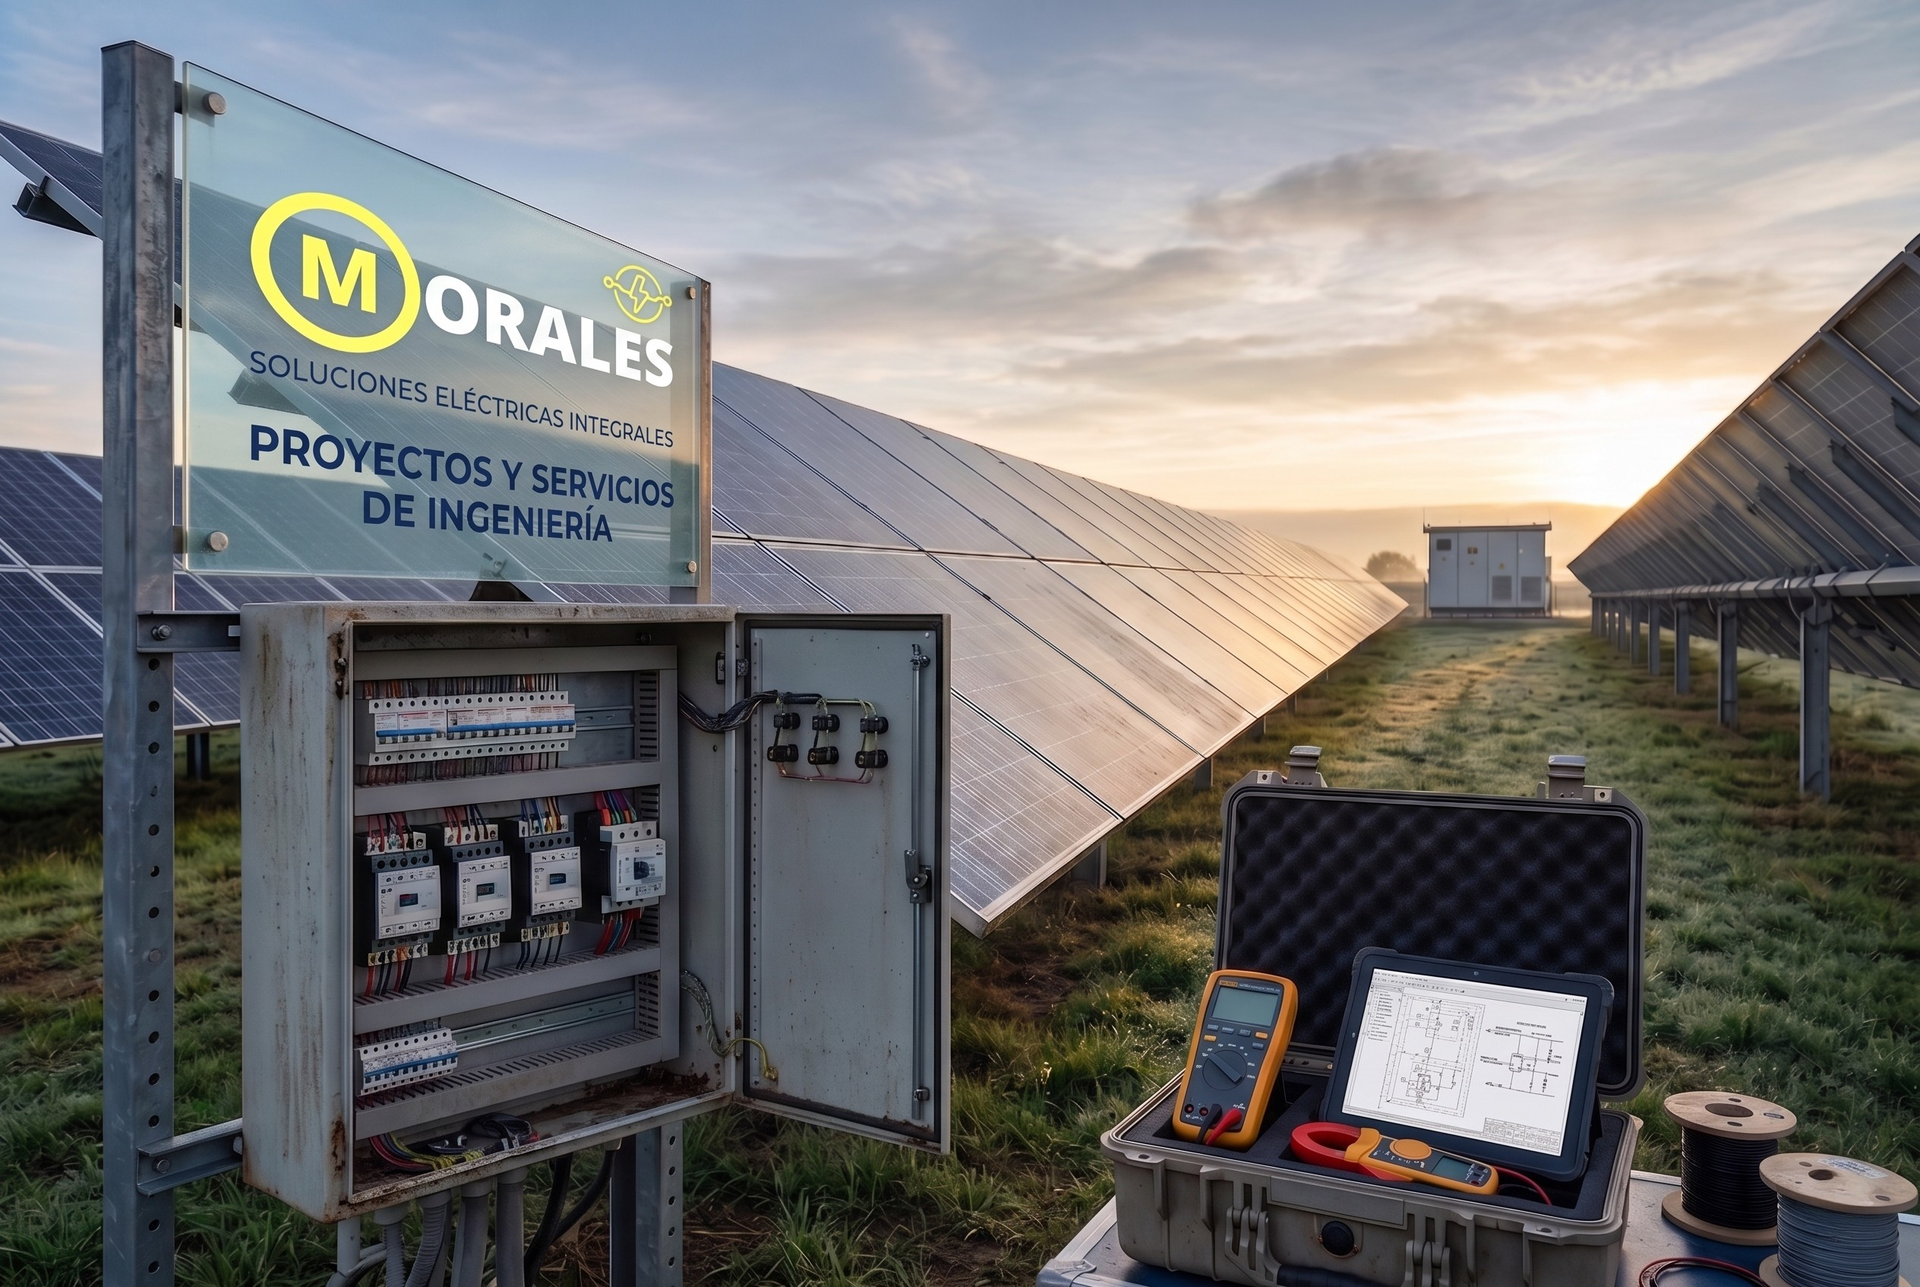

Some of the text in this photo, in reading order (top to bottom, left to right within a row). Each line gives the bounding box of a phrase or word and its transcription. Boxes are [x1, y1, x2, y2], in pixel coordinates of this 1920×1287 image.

[302, 234, 674, 388] MORALES
[250, 351, 674, 447] SOLUCIONES ELÉCTRICAS INTEGRALES
[251, 425, 675, 507] PROYECTOS Y SERVICIOS
[363, 491, 613, 542] DE INGENIERÍA
